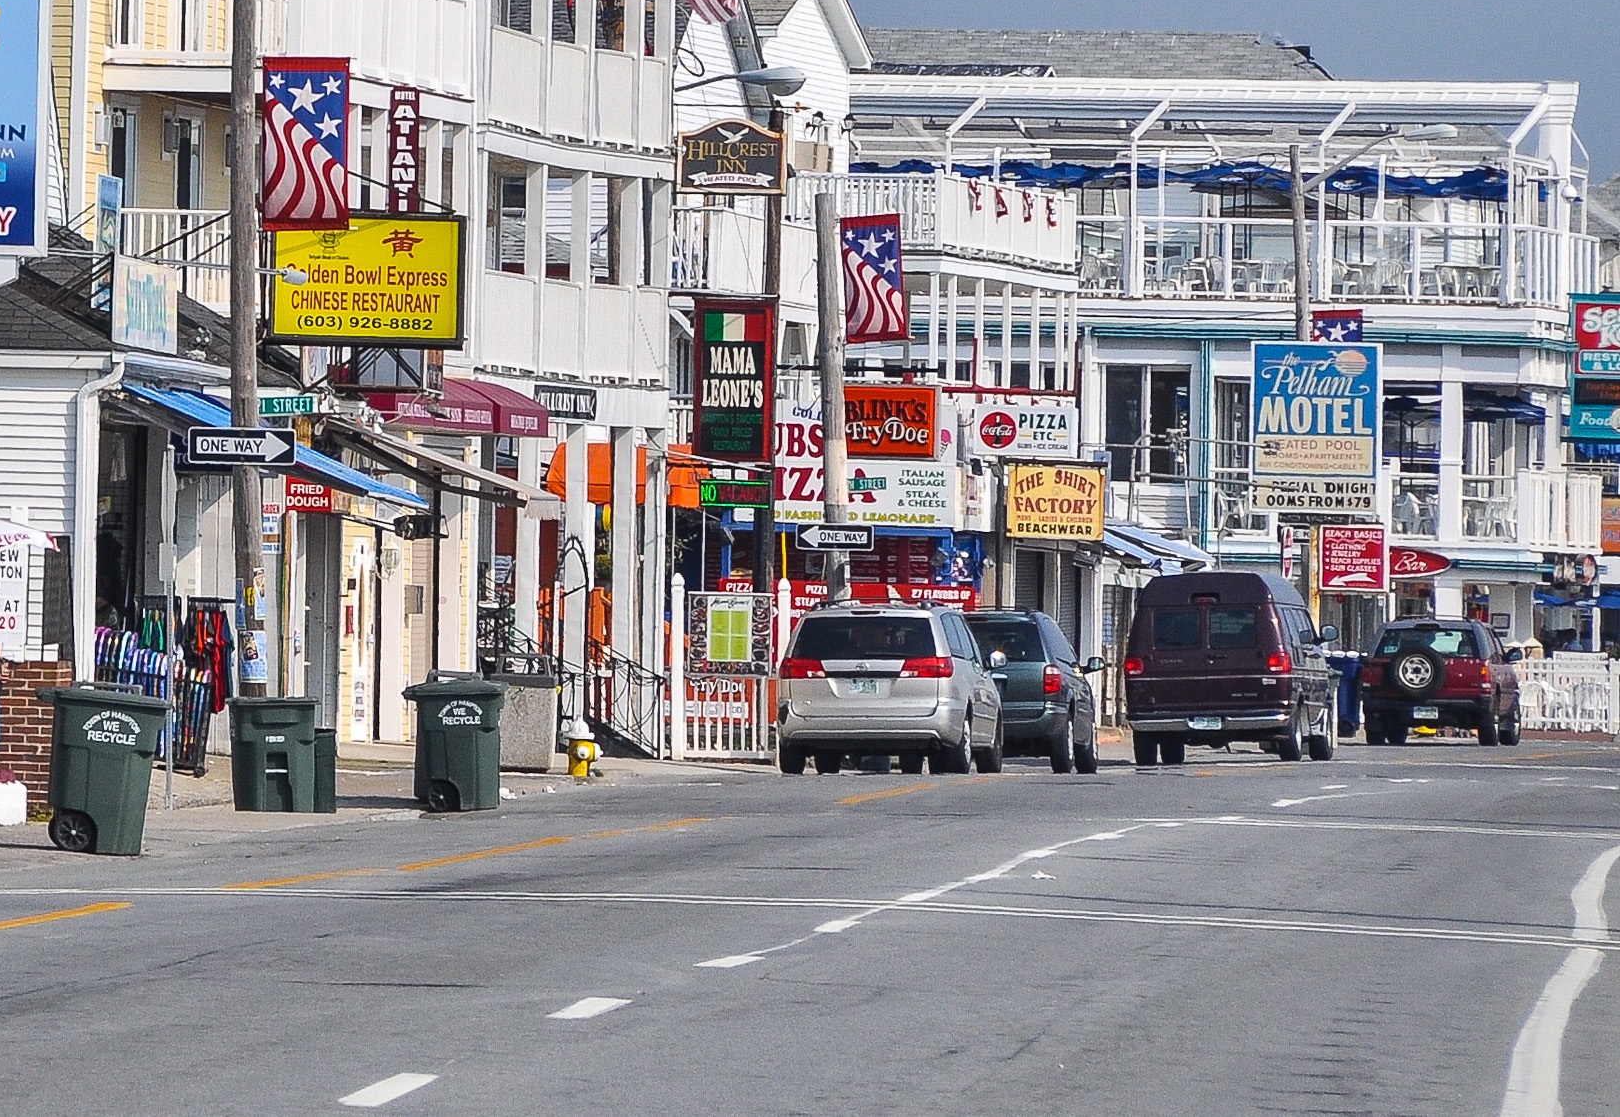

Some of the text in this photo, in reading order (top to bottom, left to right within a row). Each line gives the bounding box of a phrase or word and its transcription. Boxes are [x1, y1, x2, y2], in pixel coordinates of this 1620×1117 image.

[716, 160, 747, 173] INN
[344, 265, 448, 291] Bowl Express
[291, 290, 440, 314] CHINESE RESTAURANT
[297, 314, 433, 330] (603) 926-8882
[709, 346, 756, 375] MAMA
[1283, 352, 1300, 365] the
[1261, 365, 1370, 397] Pelham
[701, 379, 764, 409] LEONE'S
[273, 397, 311, 413] STREET
[1018, 413, 1068, 430] PIZZA
[1258, 396, 1372, 434] MOTEL
[846, 422, 883, 445] Fry
[1032, 431, 1057, 442] ETC.
[200, 438, 263, 453] ONE WAY
[1325, 441, 1361, 451] POOL
[901, 470, 944, 478] ITALIAN
[290, 484, 324, 494] FRIED
[859, 479, 885, 490] STREET
[898, 478, 946, 487] SAUSAGE
[1017, 469, 1096, 498] THE SHIRT
[701, 485, 716, 502] NO
[905, 490, 939, 499] STEAK
[286, 496, 329, 507] DOUGH
[897, 499, 947, 508] & CHEESE
[1014, 496, 1097, 515] FACTORY
[1308, 496, 1371, 508] FROM $79
[1017, 522, 1093, 536] BEACHWEAR
[1325, 530, 1351, 538] BEACH
[819, 531, 865, 543] ONE WAY
[1394, 551, 1428, 572] Bar
[4, 600, 20, 613] AT
[103, 720, 120, 732] WE
[87, 730, 137, 746] RECYCLE
